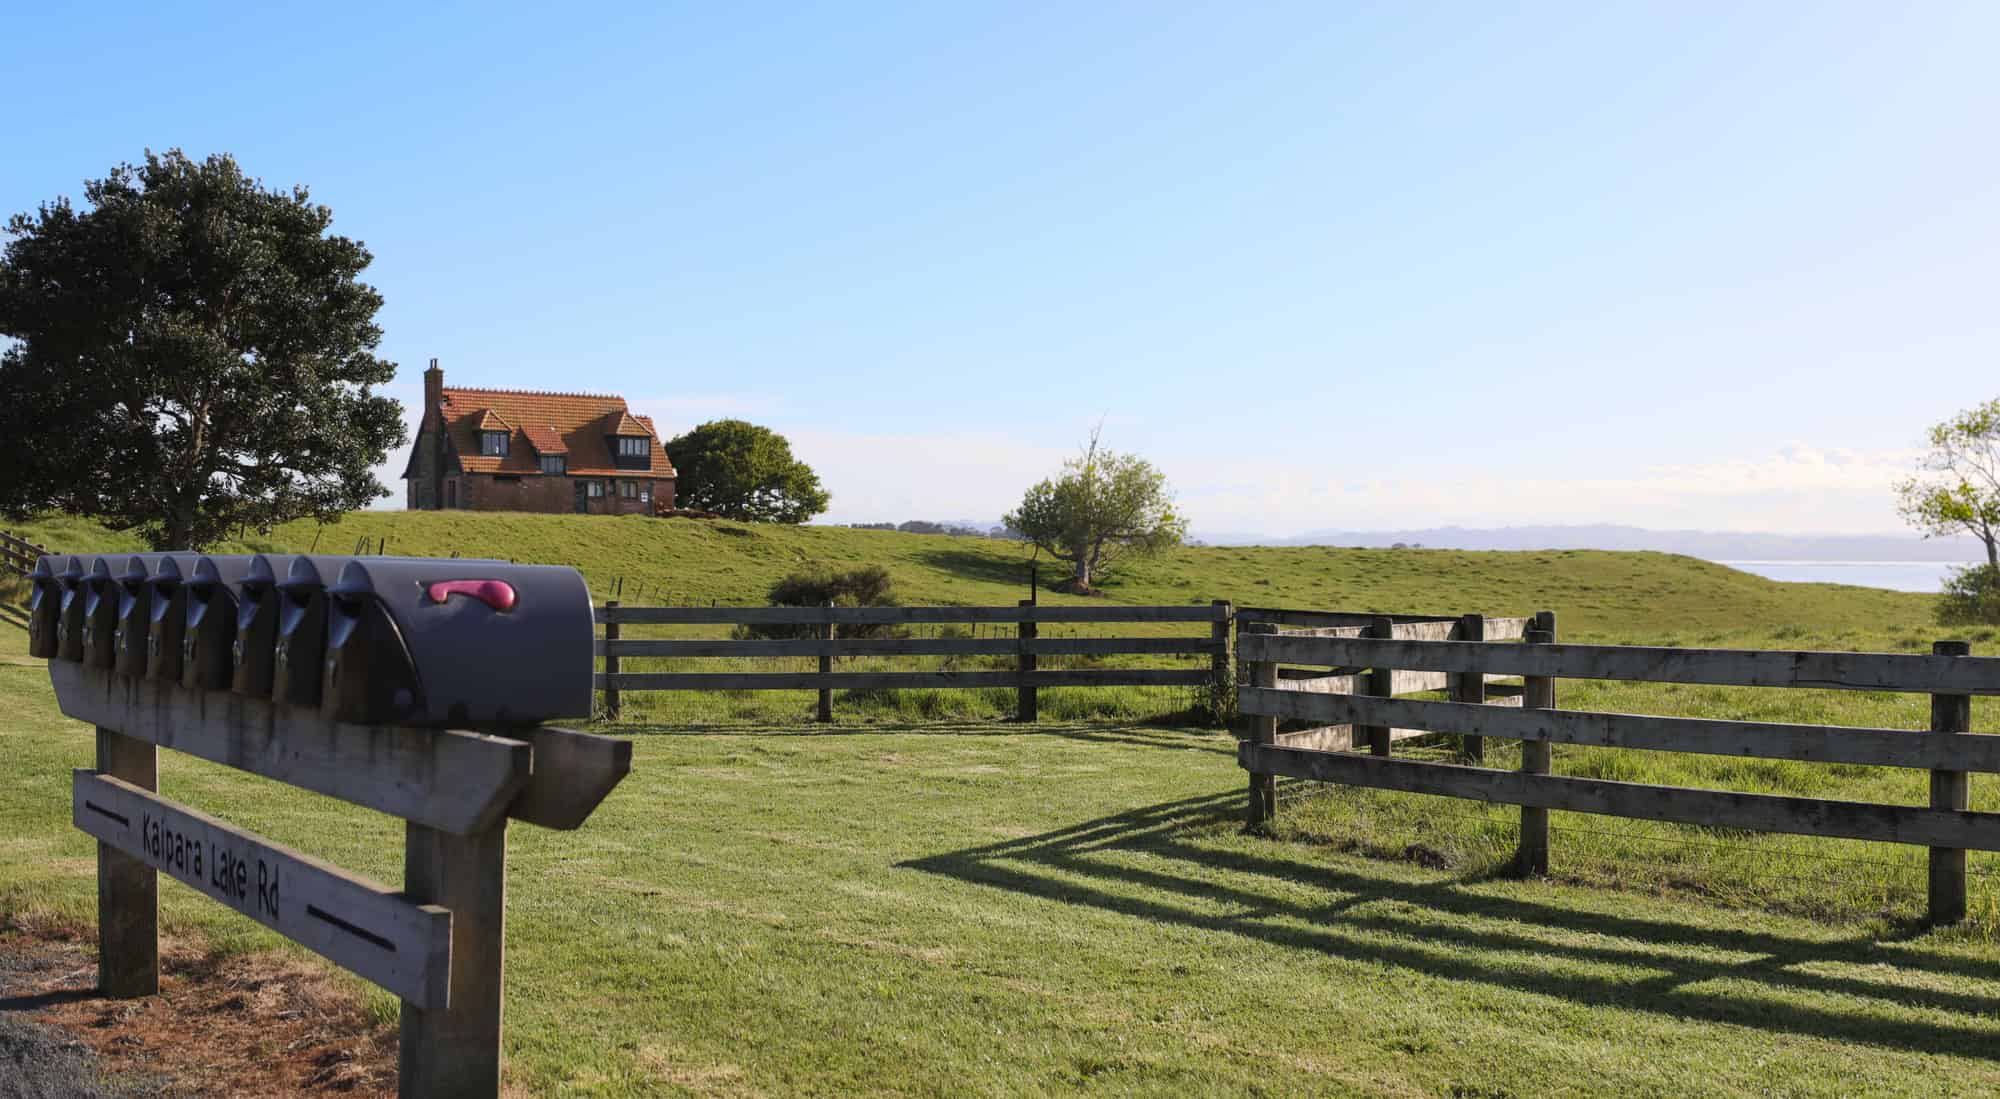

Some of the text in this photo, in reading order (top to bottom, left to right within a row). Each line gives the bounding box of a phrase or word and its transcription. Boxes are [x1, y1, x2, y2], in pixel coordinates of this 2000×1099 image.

[142, 812, 280, 919] Kaipara Lake Rd
